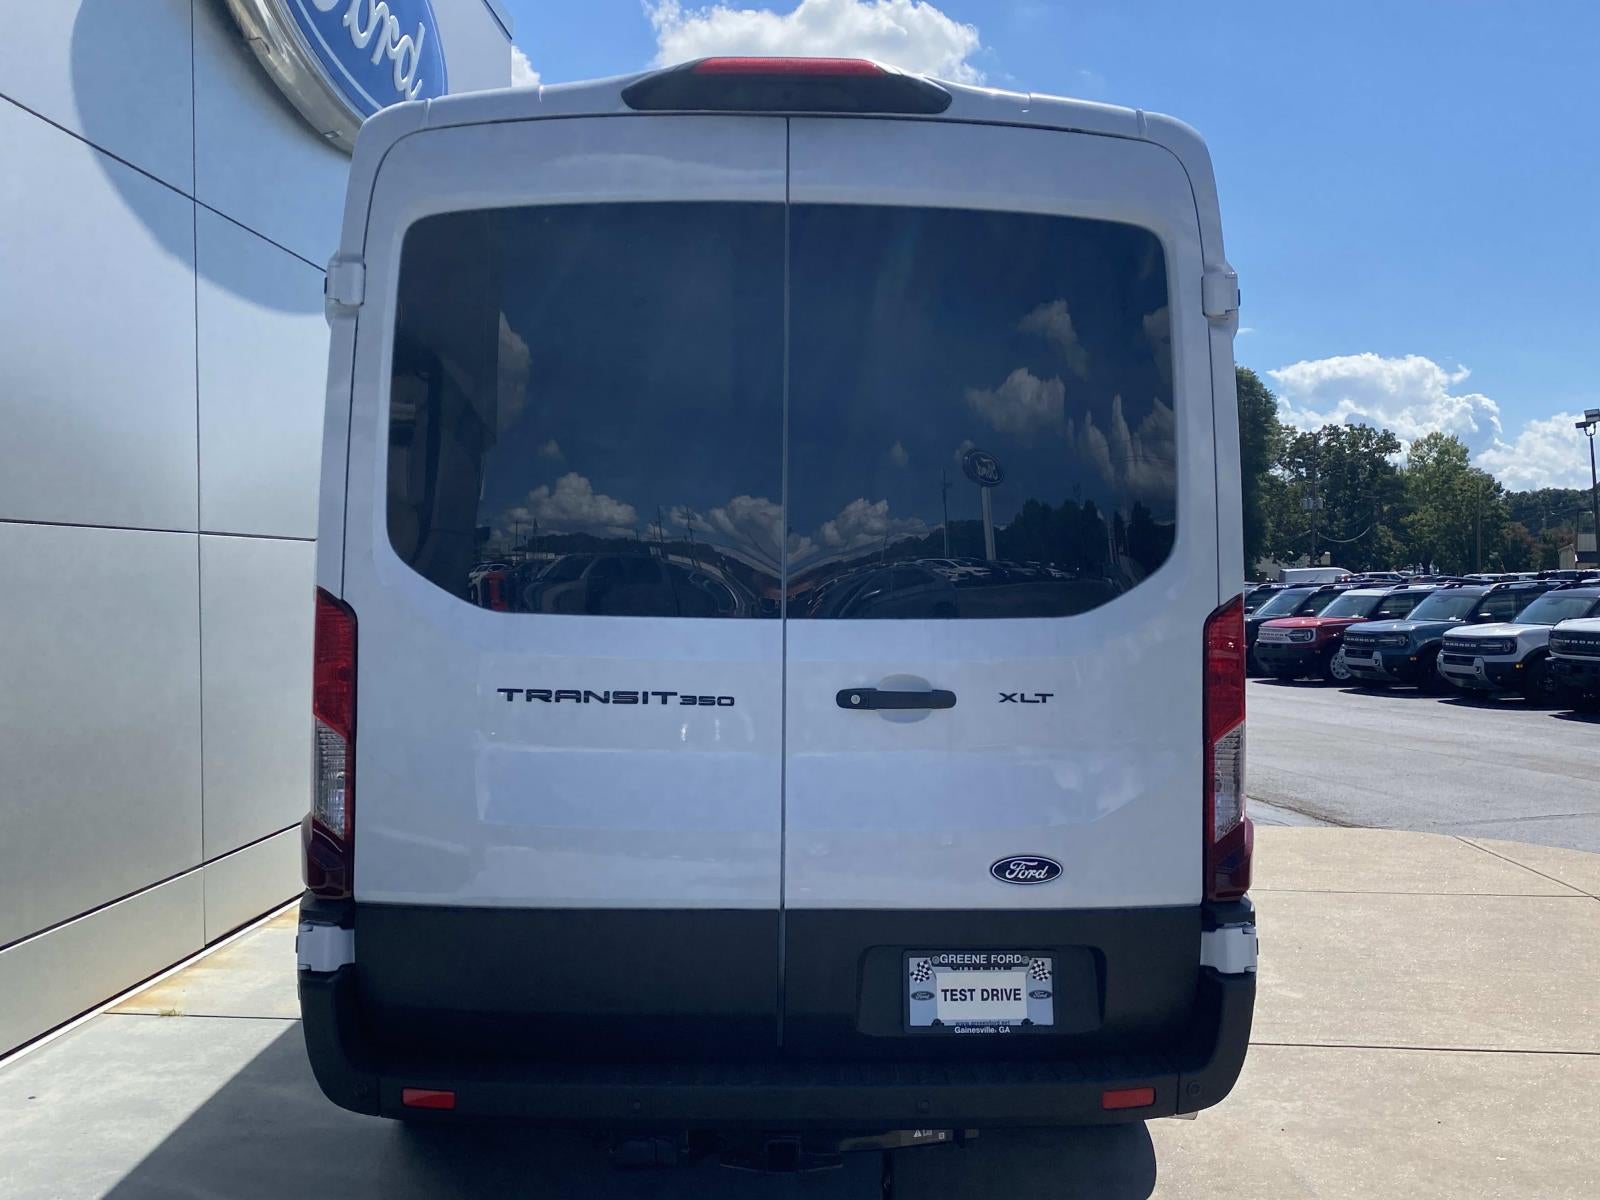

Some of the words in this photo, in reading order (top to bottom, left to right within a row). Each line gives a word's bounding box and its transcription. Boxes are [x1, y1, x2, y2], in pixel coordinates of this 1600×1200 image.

[312, 0, 426, 101] ord
[496, 688, 678, 705] TRANSIT
[679, 695, 735, 707] 350
[999, 692, 1054, 704] XLT
[1005, 860, 1049, 880] Ford
[940, 954, 988, 964] GREENE
[991, 954, 1022, 964] FORD
[941, 988, 976, 1002] TEST
[980, 988, 1022, 1002] DRIVE
[999, 1026, 1011, 1034] GA
